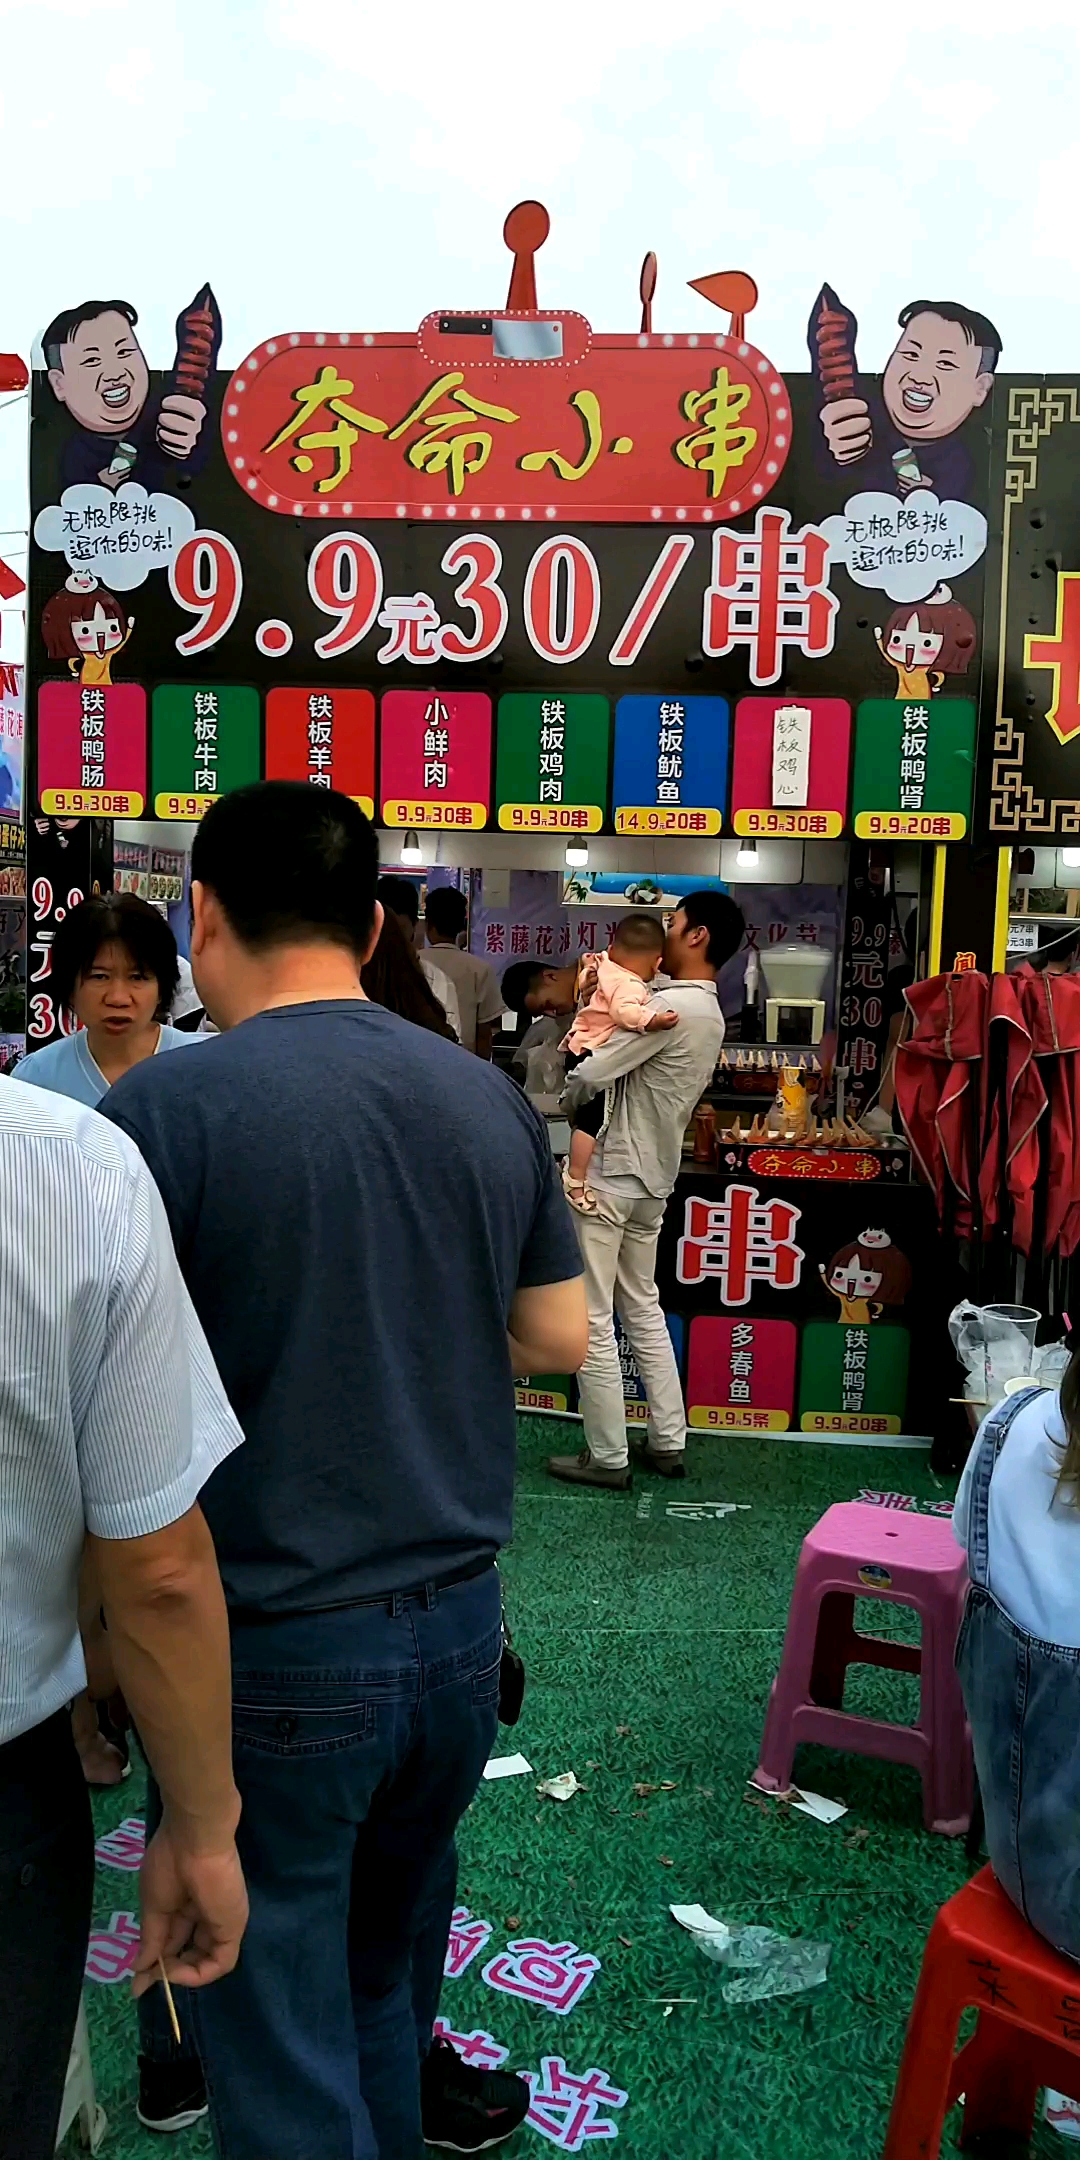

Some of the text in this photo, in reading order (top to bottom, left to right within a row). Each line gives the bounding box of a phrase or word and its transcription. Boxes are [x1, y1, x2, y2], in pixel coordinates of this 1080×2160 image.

[262, 365, 758, 498] 夺命小串
[62, 501, 157, 533] 无极限挑
[845, 510, 948, 543] 无极限挑
[80, 688, 106, 788] 铁板鸭肠
[193, 691, 219, 792] 铁板牛肉
[307, 694, 333, 790] 铁板羊肉
[423, 697, 449, 789] 小鲜肉
[539, 699, 566, 803] 铁板鸡肉
[656, 701, 685, 804] 铁板鱿鱼
[775, 715, 803, 795] 铁板鸡心
[900, 705, 929, 810] 铁板鸭肾
[55, 793, 130, 814] 9.9元30串
[396, 805, 473, 826] 9.9元30串
[512, 808, 589, 829] 9.9元30串
[0, 823, 25, 850] 蛋仔冰
[617, 811, 707, 831] 14.9元20串
[748, 813, 828, 834] 9.9元30串
[869, 816, 951, 836] 9.9元20串
[1006, 937, 1034, 947] 元3串
[1007, 923, 1034, 935] 元7串
[760, 1153, 874, 1178] 夺命小串
[676, 1184, 805, 1306] 串
[727, 1321, 754, 1404] 多春鱼
[842, 1328, 869, 1412] 铁板鸭肾
[814, 1415, 888, 1433] 9.9元20串
